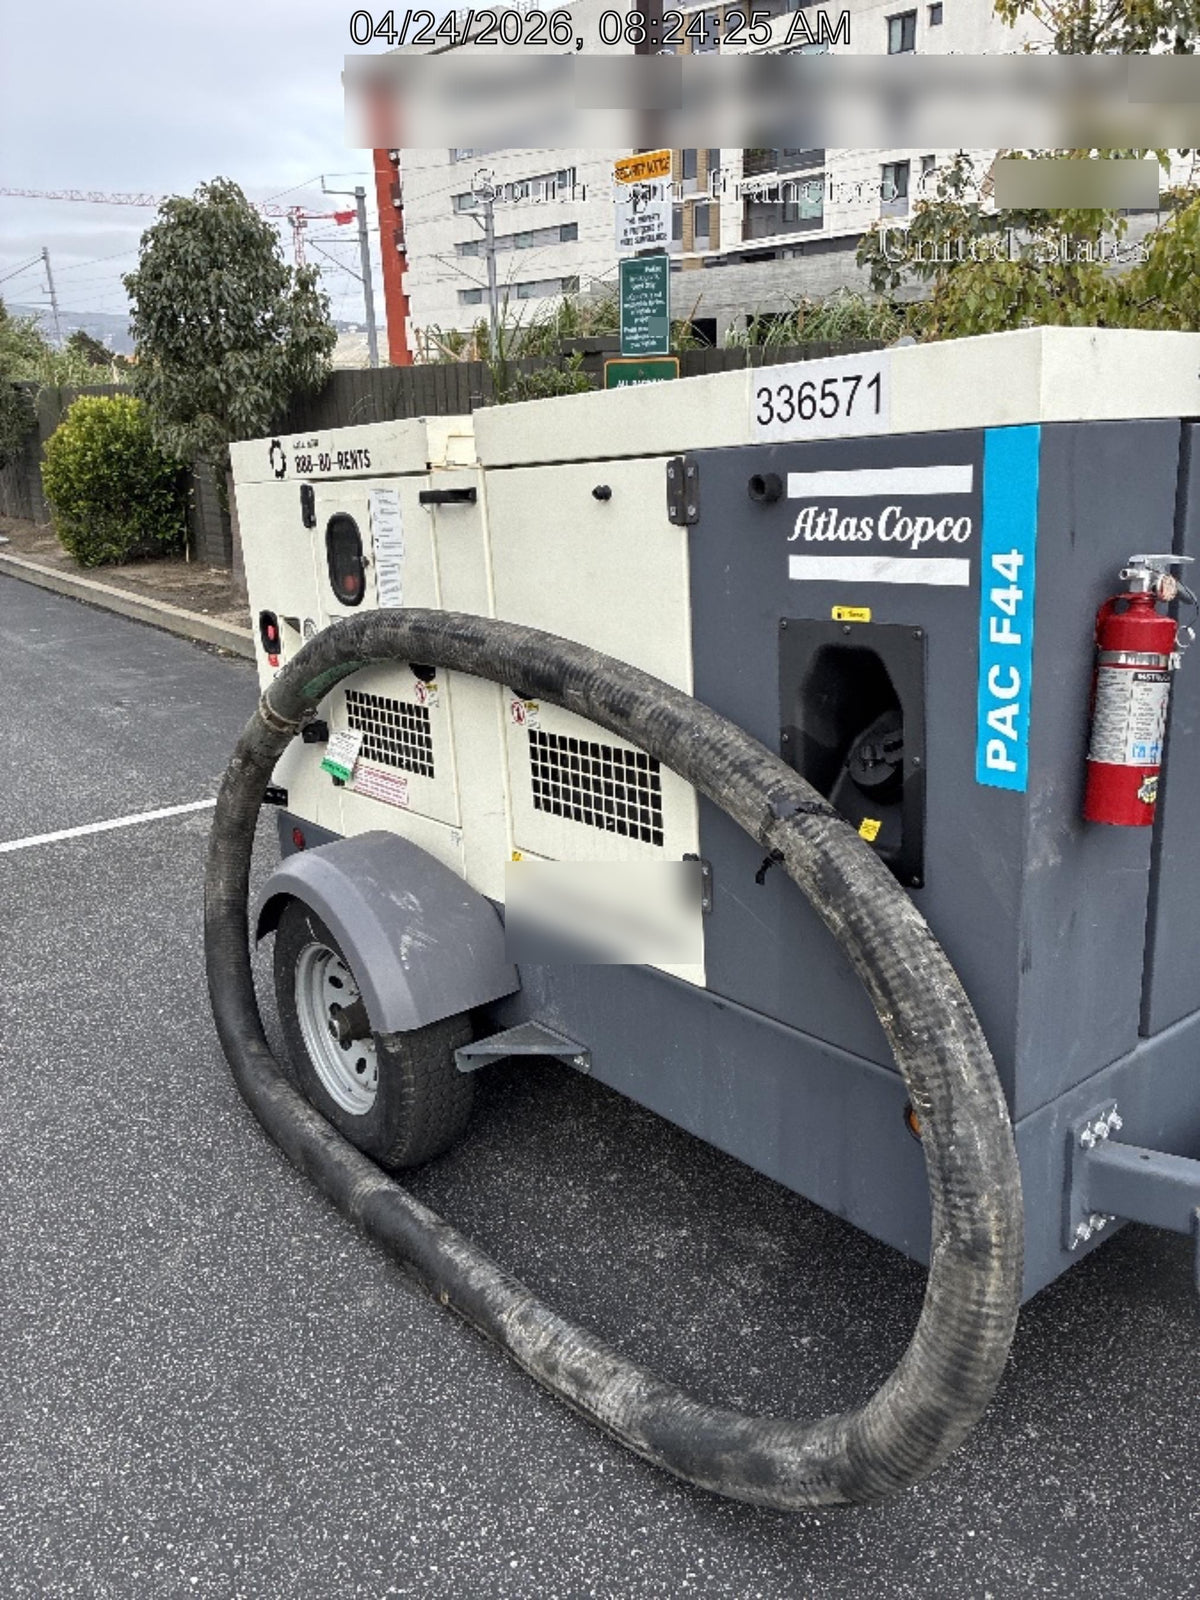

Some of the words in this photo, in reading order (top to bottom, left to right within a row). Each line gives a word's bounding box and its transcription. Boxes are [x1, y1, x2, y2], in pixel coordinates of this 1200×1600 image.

[756, 371, 882, 426] 336571
[787, 506, 874, 542] Atlas
[877, 505, 972, 550] Copco
[989, 548, 1024, 645] F44
[985, 664, 1021, 773] PAC
